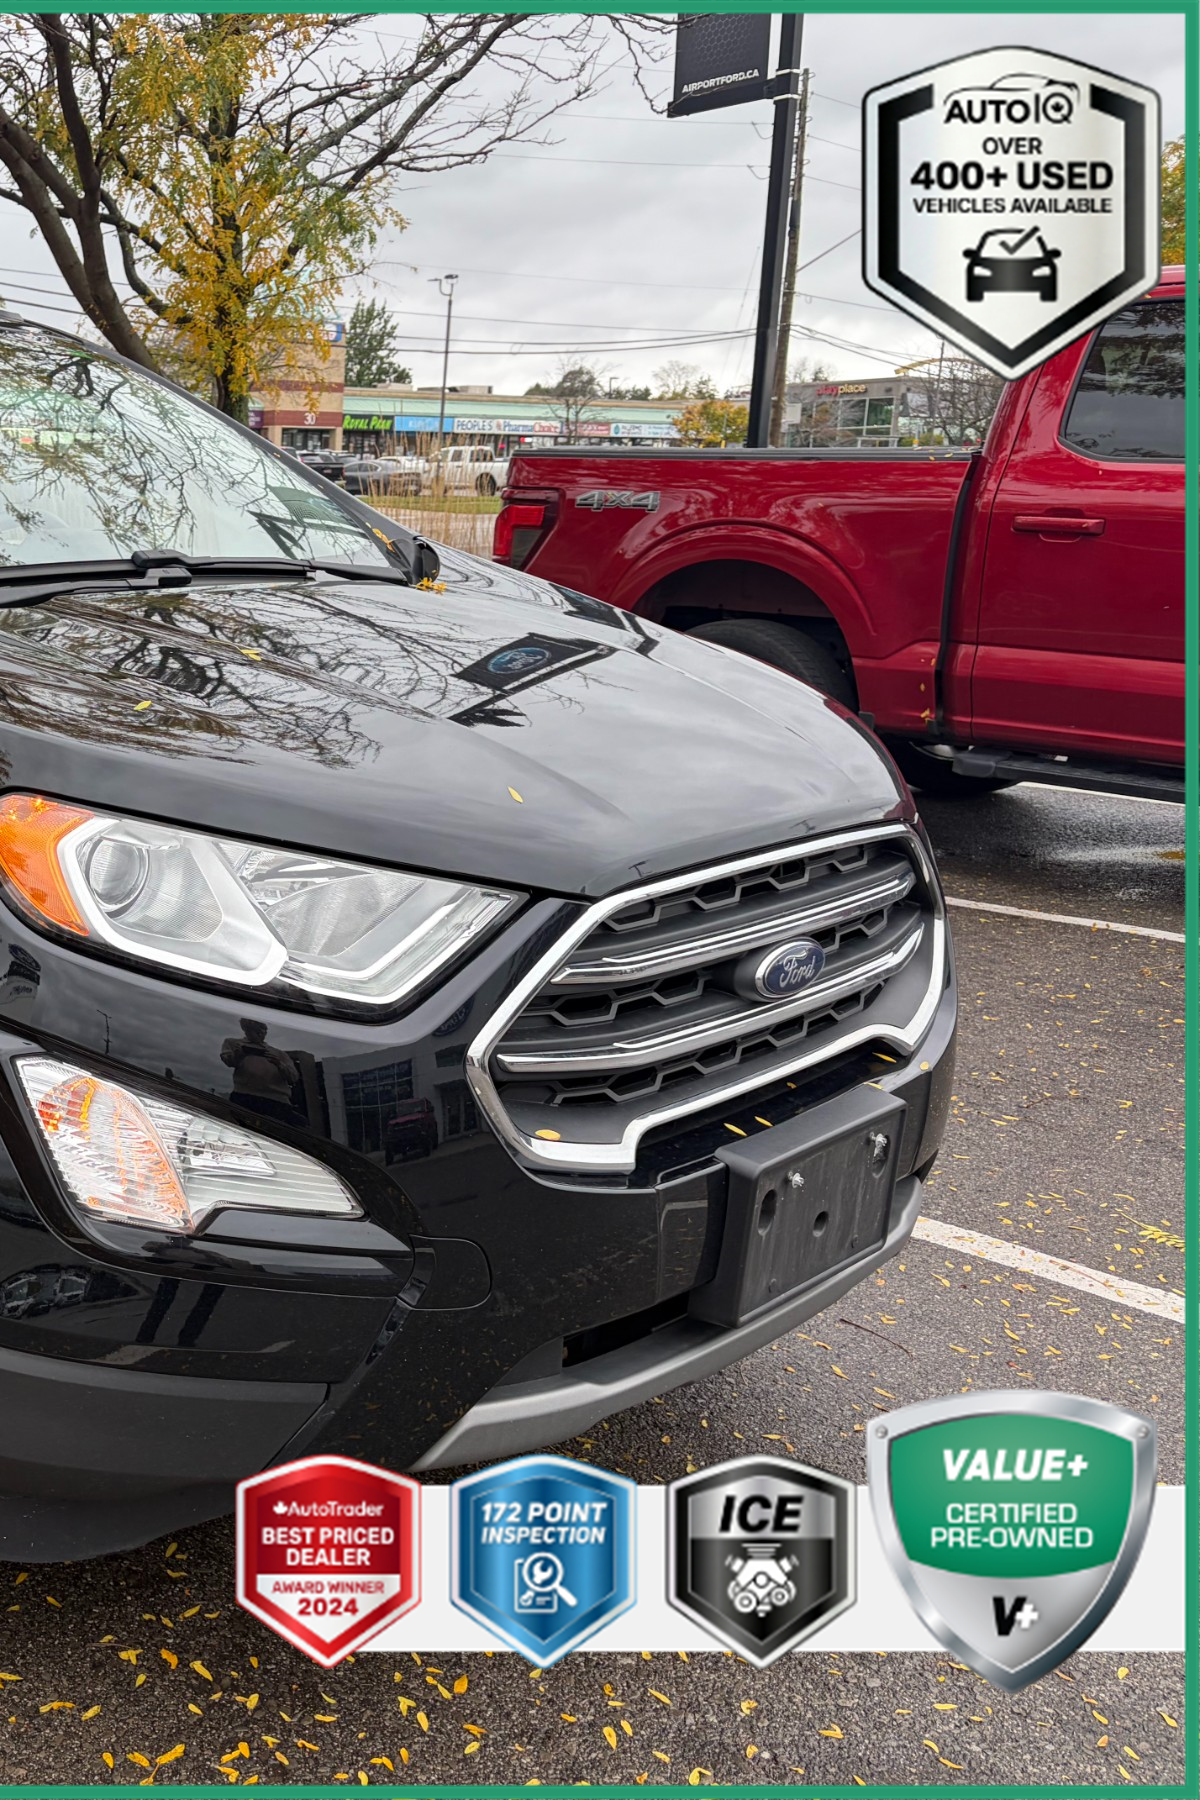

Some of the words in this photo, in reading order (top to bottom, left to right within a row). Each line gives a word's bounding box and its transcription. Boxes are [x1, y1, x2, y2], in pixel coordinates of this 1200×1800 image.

[681, 69, 760, 94] AIRPORTFORD.CA
[303, 412, 317, 426] 30
[779, 947, 816, 988] Ford
